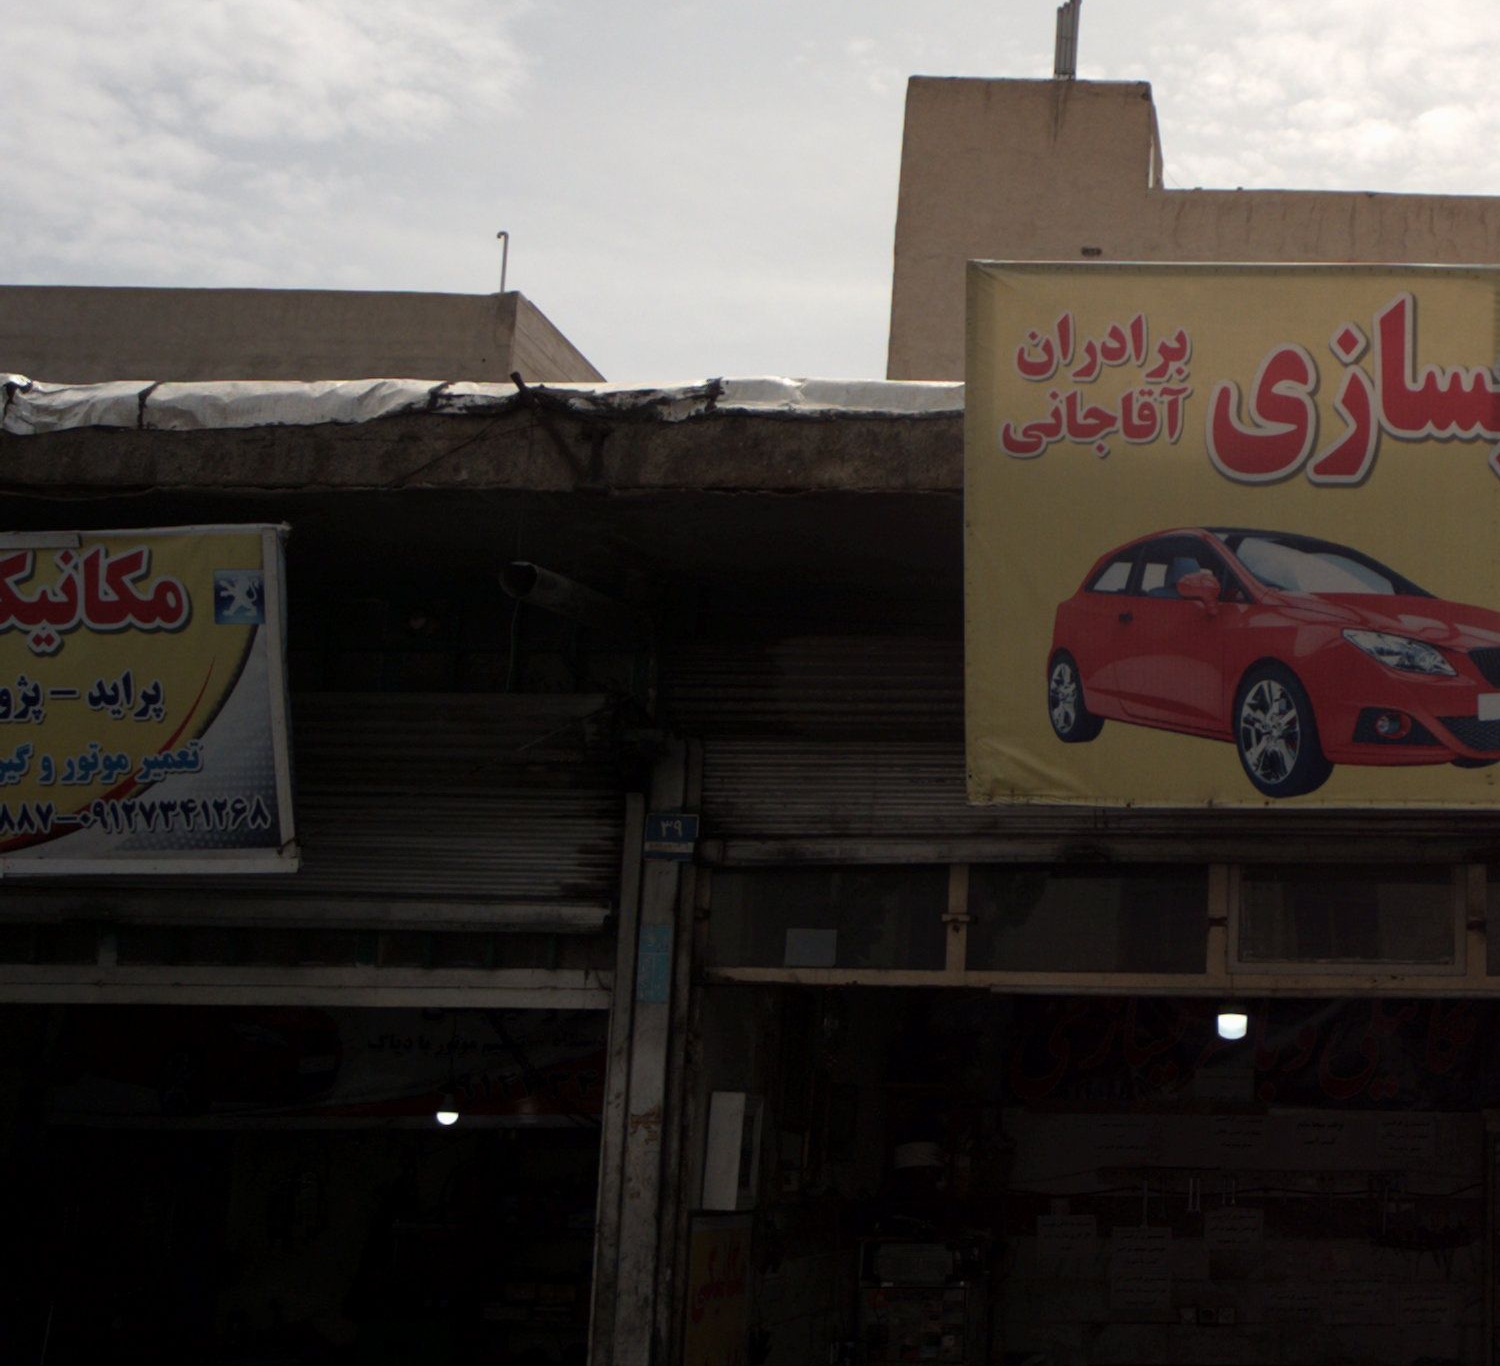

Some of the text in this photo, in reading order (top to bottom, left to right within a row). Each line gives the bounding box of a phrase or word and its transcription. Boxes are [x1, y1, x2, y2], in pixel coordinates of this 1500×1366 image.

[1016, 310, 1191, 381] برادران
[1001, 387, 1192, 458] آقاجانی
[87, 669, 166, 722] پراید
[37, 753, 56, 785] و
[60, 741, 131, 785] موتور
[137, 739, 204, 782] تعمیر
